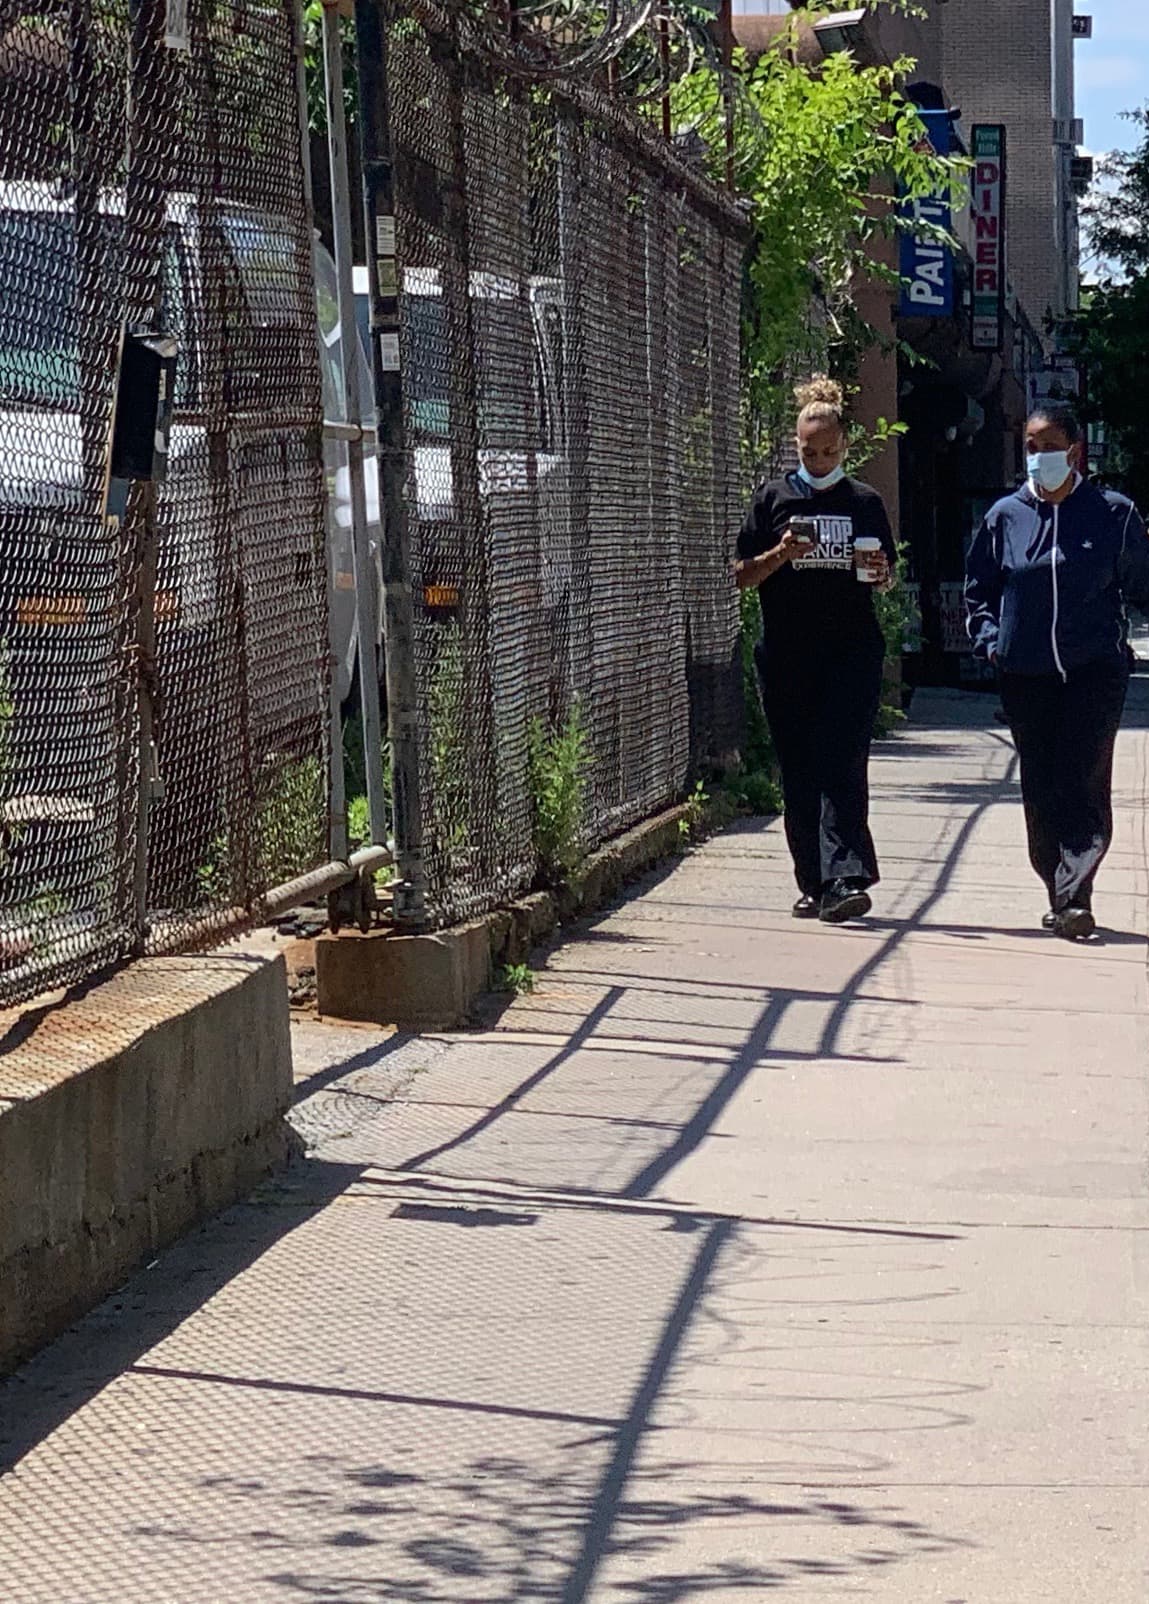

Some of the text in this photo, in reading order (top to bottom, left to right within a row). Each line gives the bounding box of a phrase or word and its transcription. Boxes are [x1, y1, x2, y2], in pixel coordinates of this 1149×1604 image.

[910, 184, 944, 306] PAIT
[976, 162, 998, 291] DINER
[803, 543, 853, 559] ANCE
[820, 520, 853, 543] HOP
